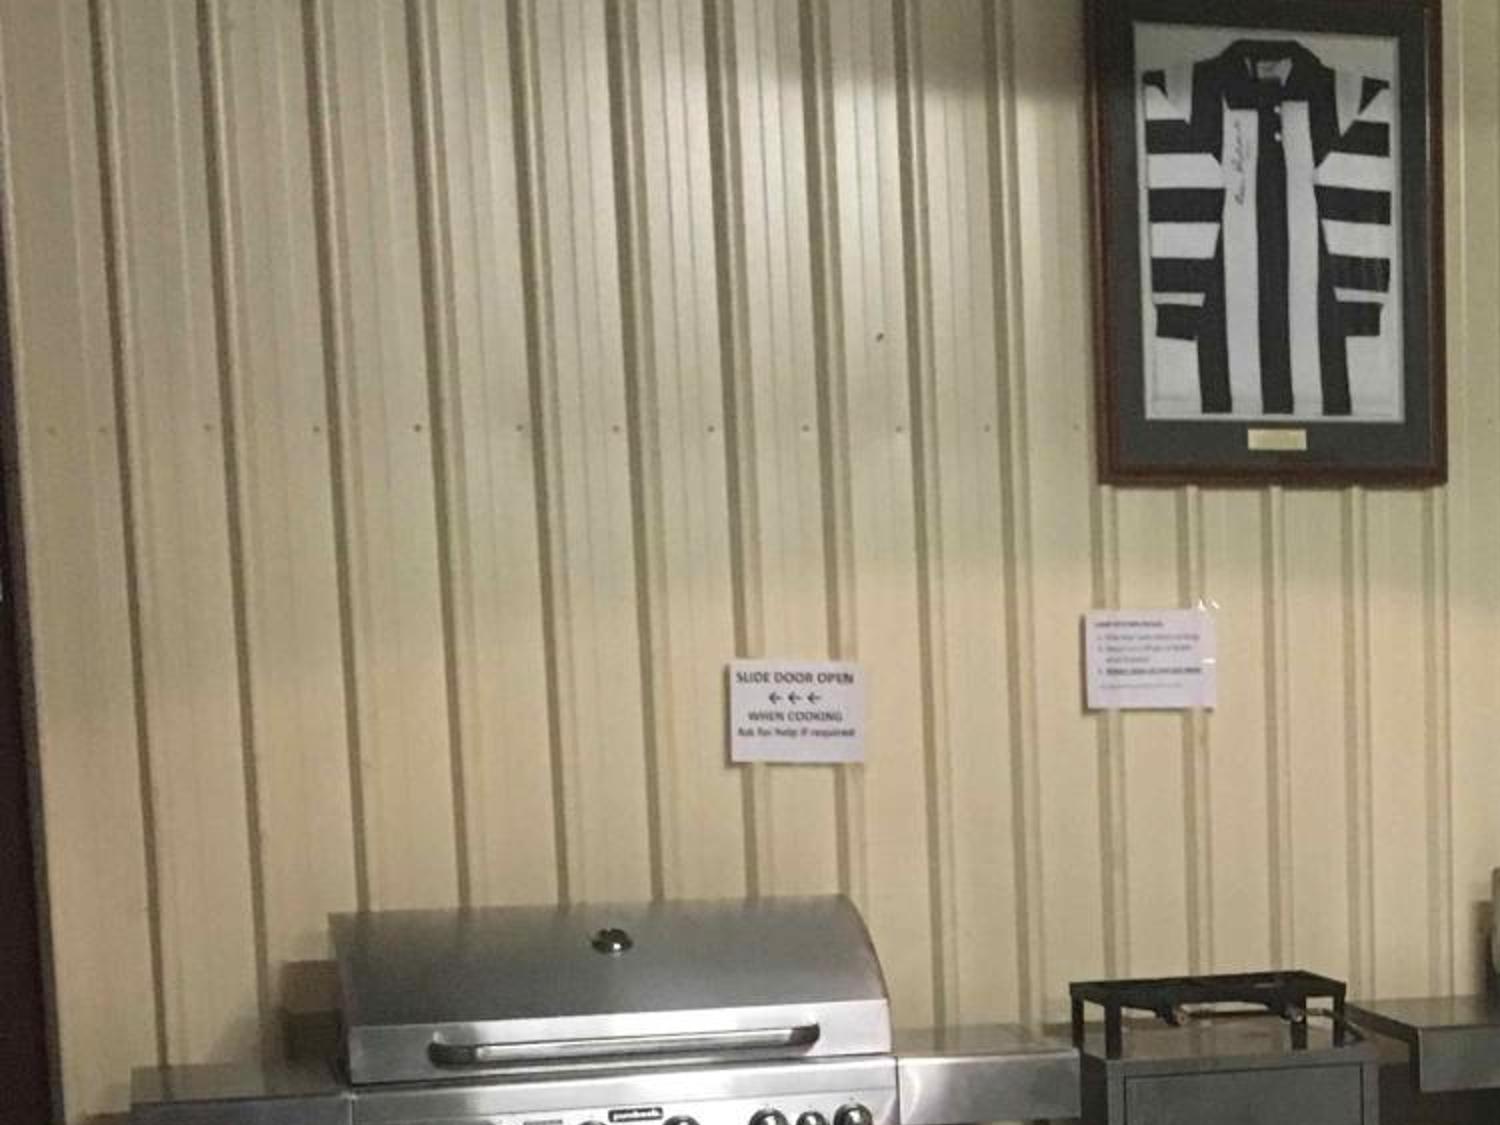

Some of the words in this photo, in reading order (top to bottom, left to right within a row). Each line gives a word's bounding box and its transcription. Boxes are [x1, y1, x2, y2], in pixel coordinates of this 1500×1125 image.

[736, 671, 770, 683] SLIDE
[773, 671, 813, 683] DOOR
[817, 672, 854, 684] OPEN
[749, 711, 785, 721] WHEN
[787, 711, 843, 721] COOKING
